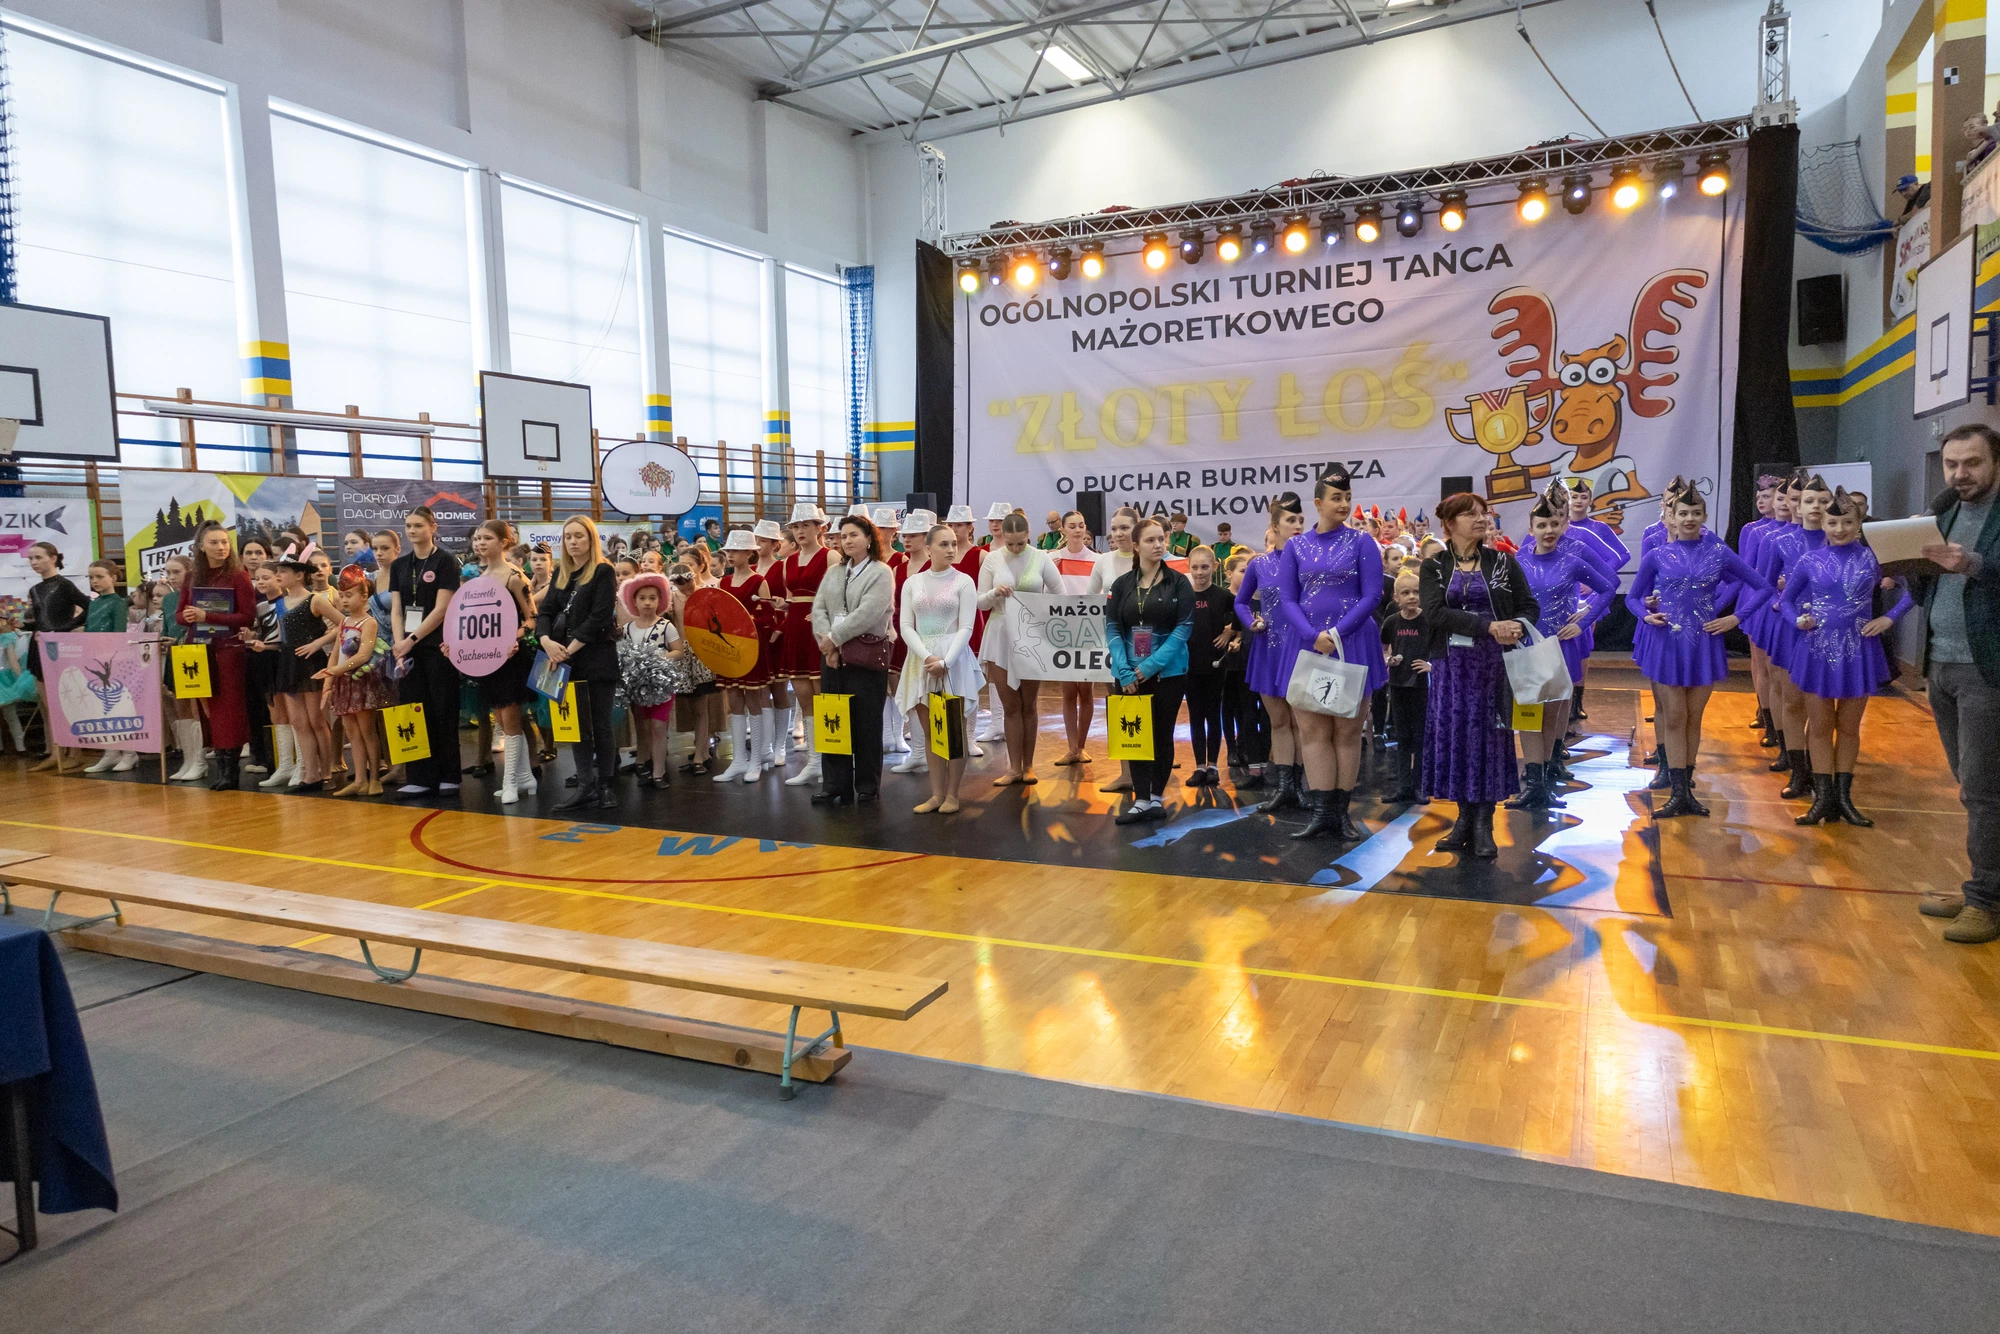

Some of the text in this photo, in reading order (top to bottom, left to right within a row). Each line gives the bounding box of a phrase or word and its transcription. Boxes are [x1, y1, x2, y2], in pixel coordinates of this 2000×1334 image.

[979, 243, 1514, 327] OGÓLNOPOLSKI TURNIEJ TAŃCA
[1071, 298, 1385, 353] MAŻORETKOWEGO
[1056, 459, 1386, 494] O PUCHAR BURMISTZA
[342, 492, 409, 504] POKRYCIA
[0, 513, 42, 528] ZIK
[343, 508, 411, 519] DACHOWE
[462, 587, 497, 600] Mażoretki
[458, 612, 502, 641] FOCH
[456, 647, 503, 664] Suchowola
[76, 717, 143, 733] TORNADO
